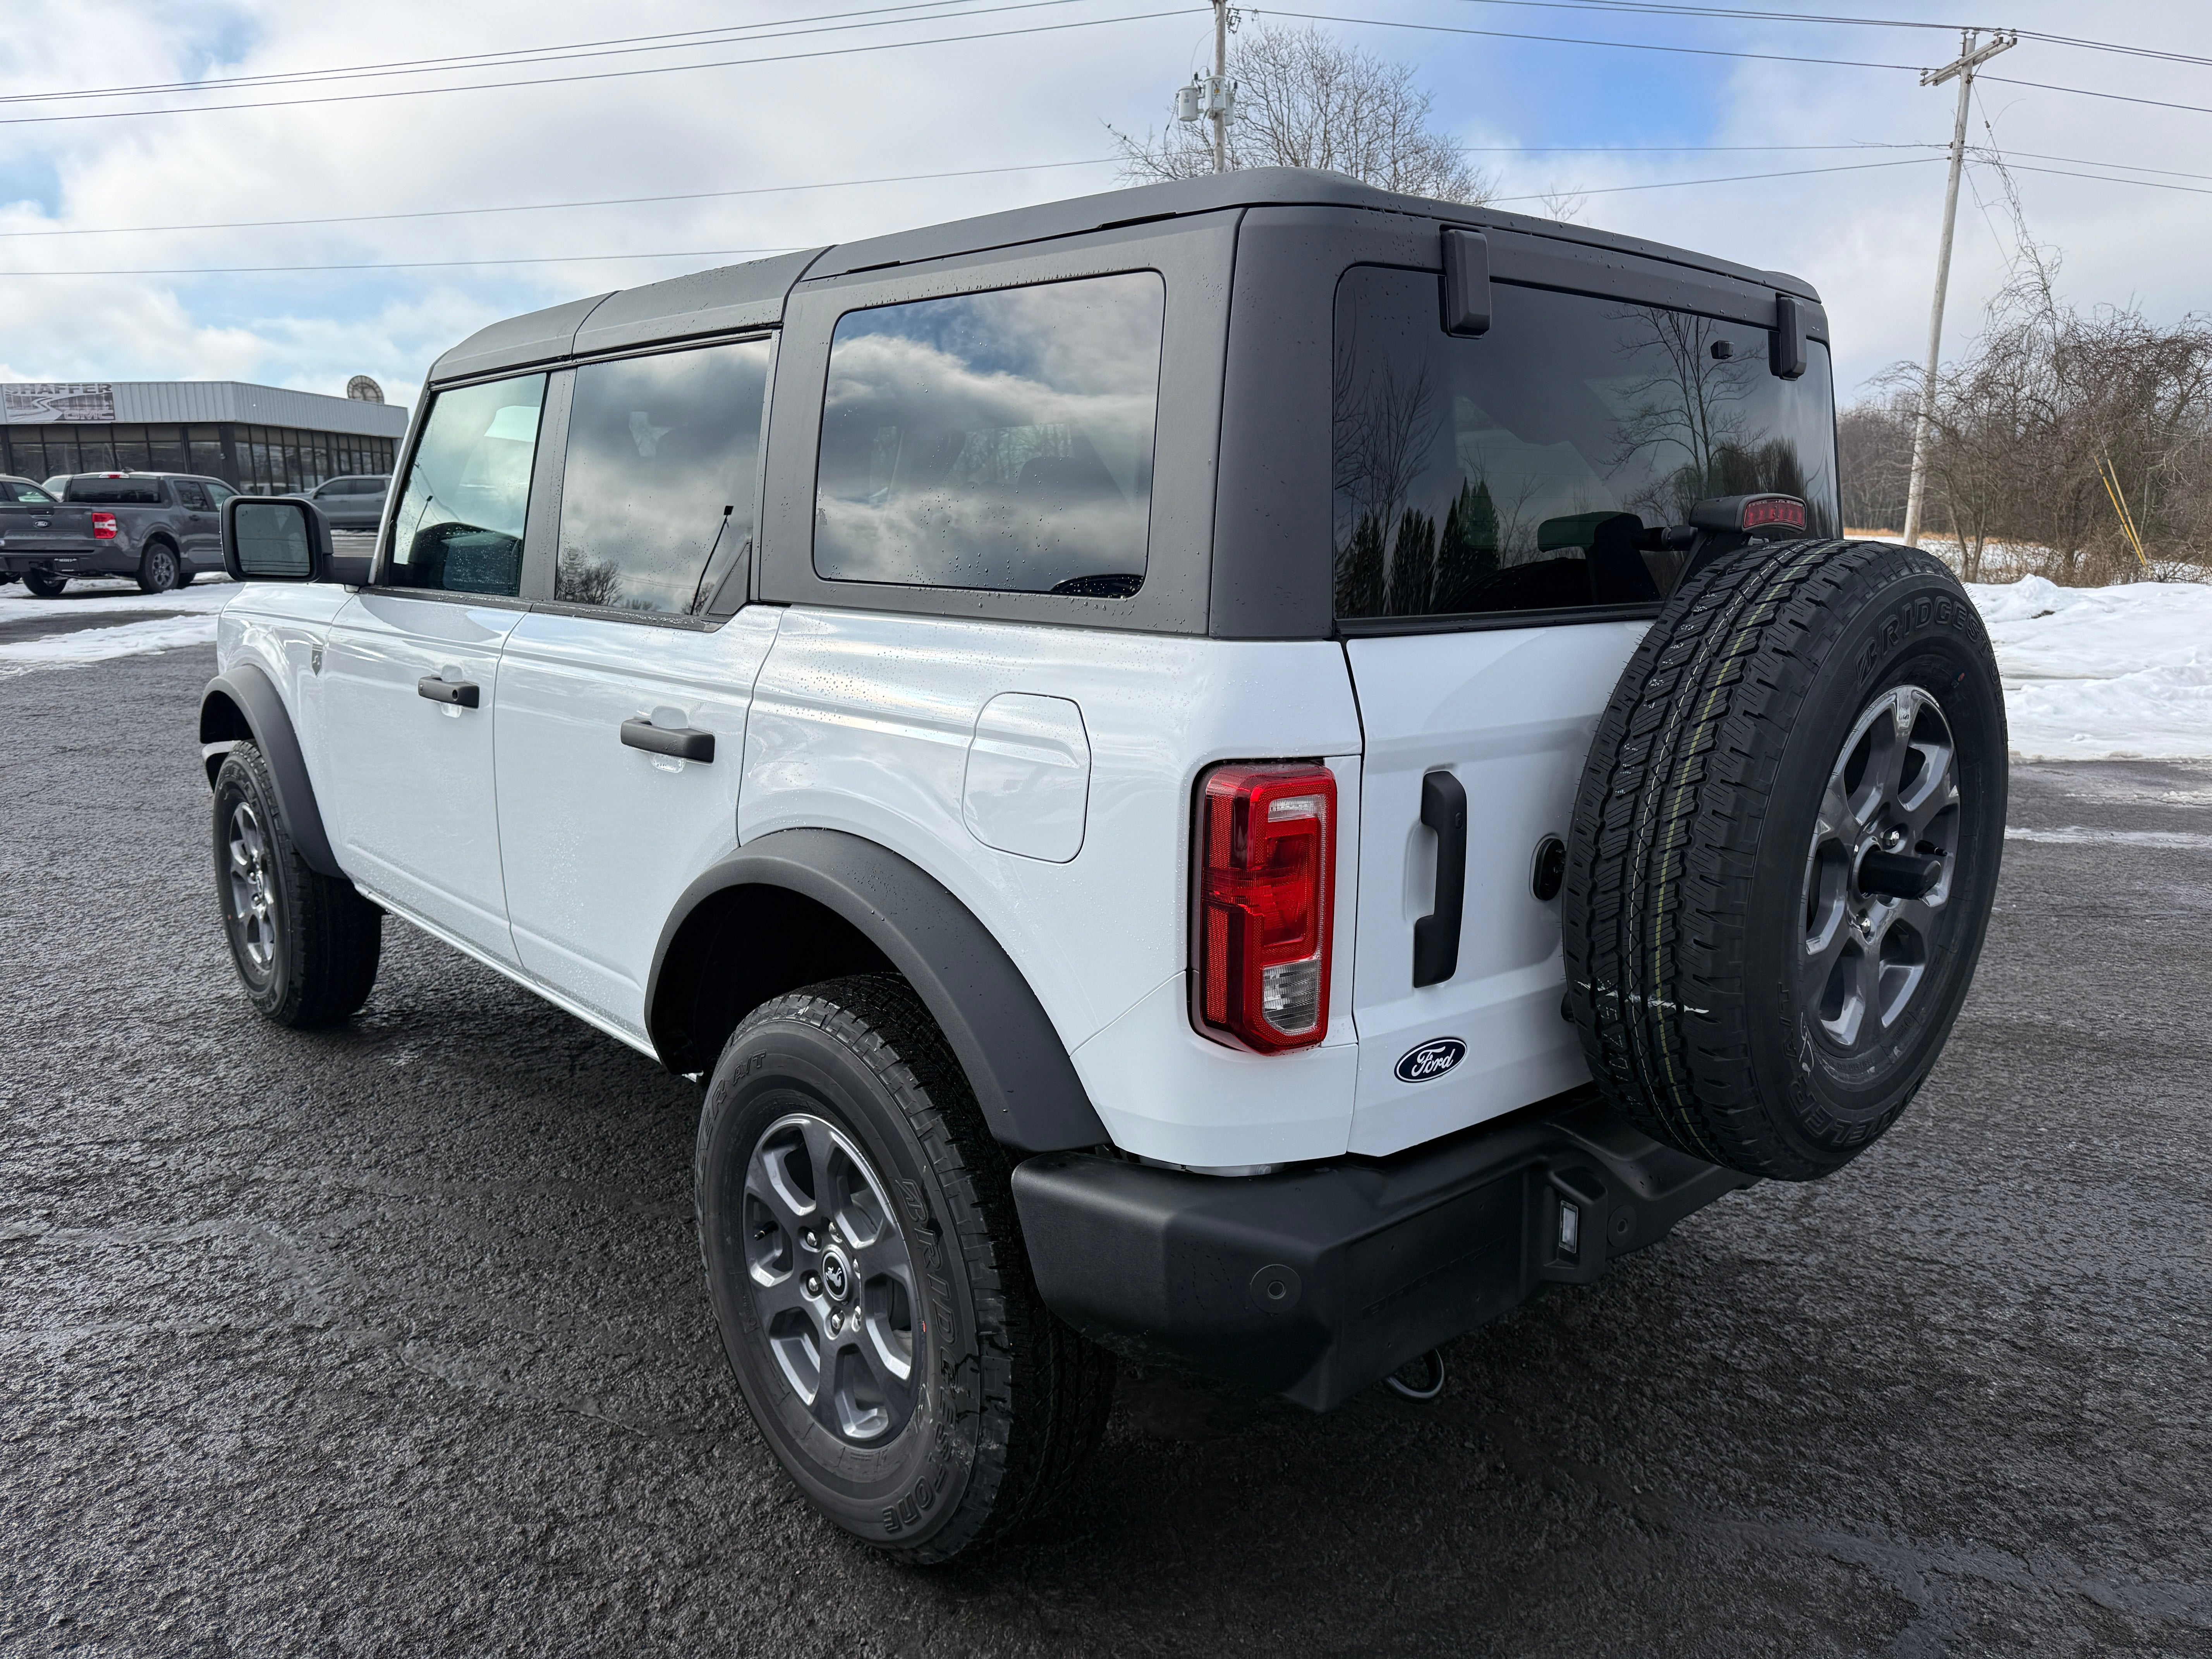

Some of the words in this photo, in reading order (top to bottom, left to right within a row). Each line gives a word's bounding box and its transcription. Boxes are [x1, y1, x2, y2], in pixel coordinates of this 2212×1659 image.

[5, 383, 113, 394] SHAFFER
[64, 410, 114, 420] GMC
[1855, 595, 2008, 745] BRIDGESTONE
[733, 1049, 768, 1086] A/T
[1411, 1046, 1456, 1077] Ford
[882, 1178, 959, 1534] BRIDGESTONE
